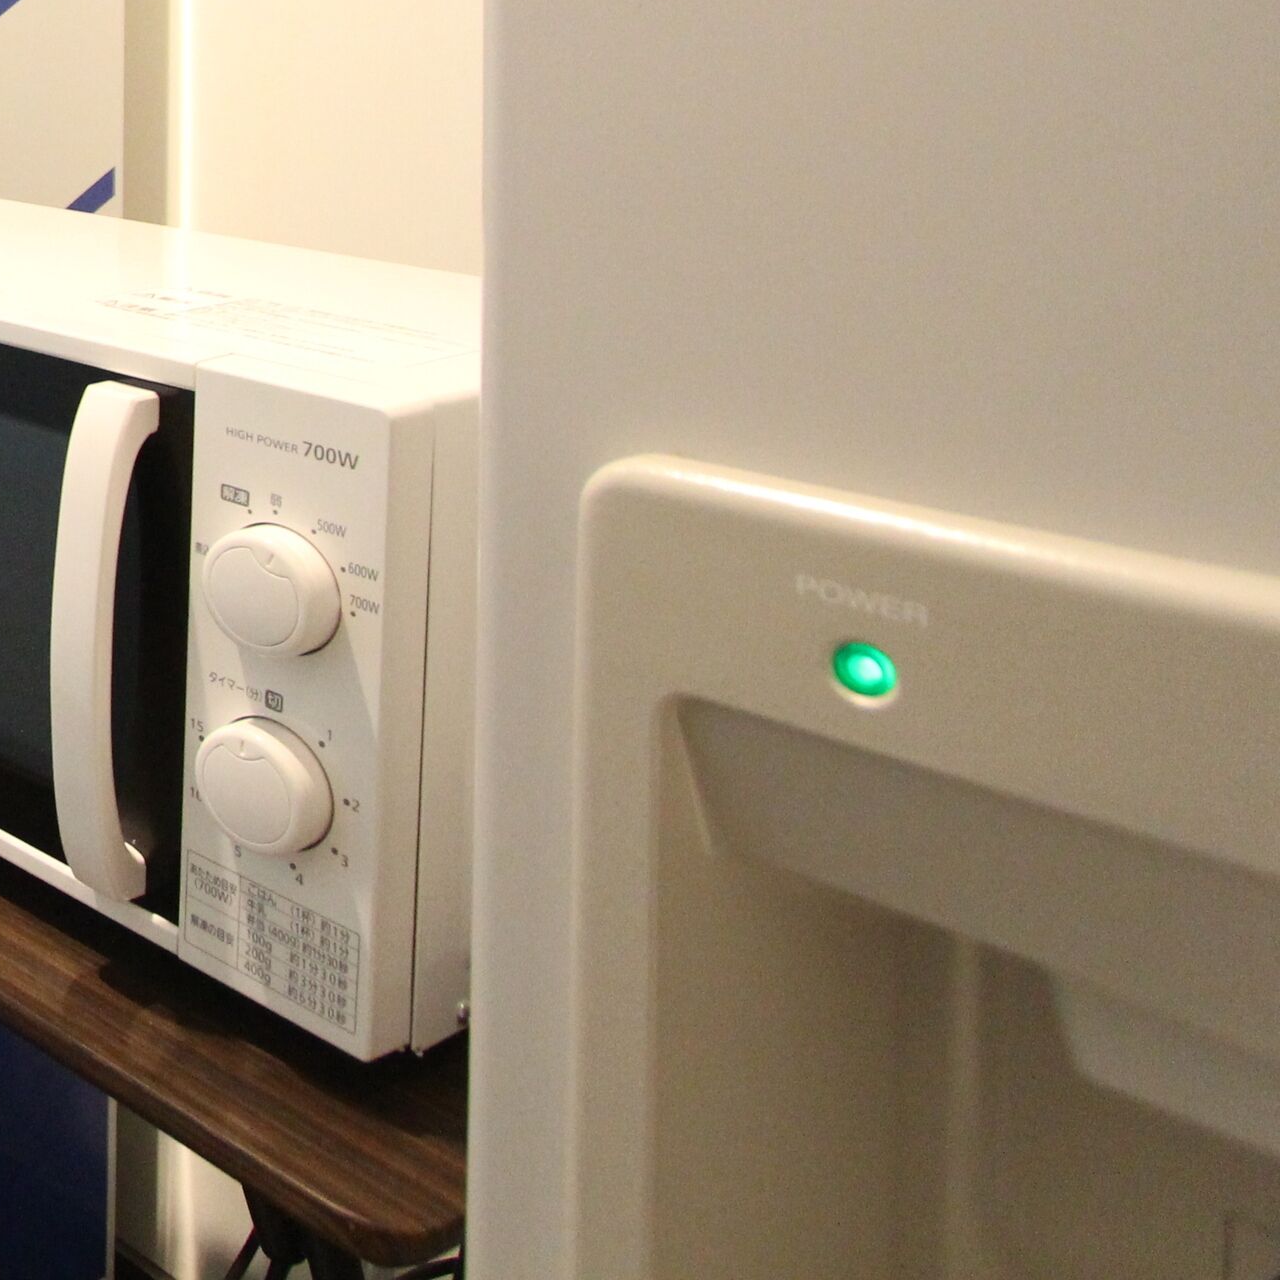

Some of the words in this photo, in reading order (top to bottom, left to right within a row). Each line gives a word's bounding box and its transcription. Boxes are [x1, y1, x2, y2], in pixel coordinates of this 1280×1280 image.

[225, 426, 254, 443] HIGH
[256, 434, 299, 454] POWER
[302, 440, 360, 470] 700W
[316, 518, 347, 539] 500W
[348, 562, 380, 582] 600W
[349, 594, 381, 616] 700W
[794, 573, 930, 628] POWER
[191, 717, 204, 732] 15
[352, 799, 360, 812] 2
[234, 844, 242, 858] 5
[341, 854, 349, 868] 3
[295, 872, 304, 886] 4
